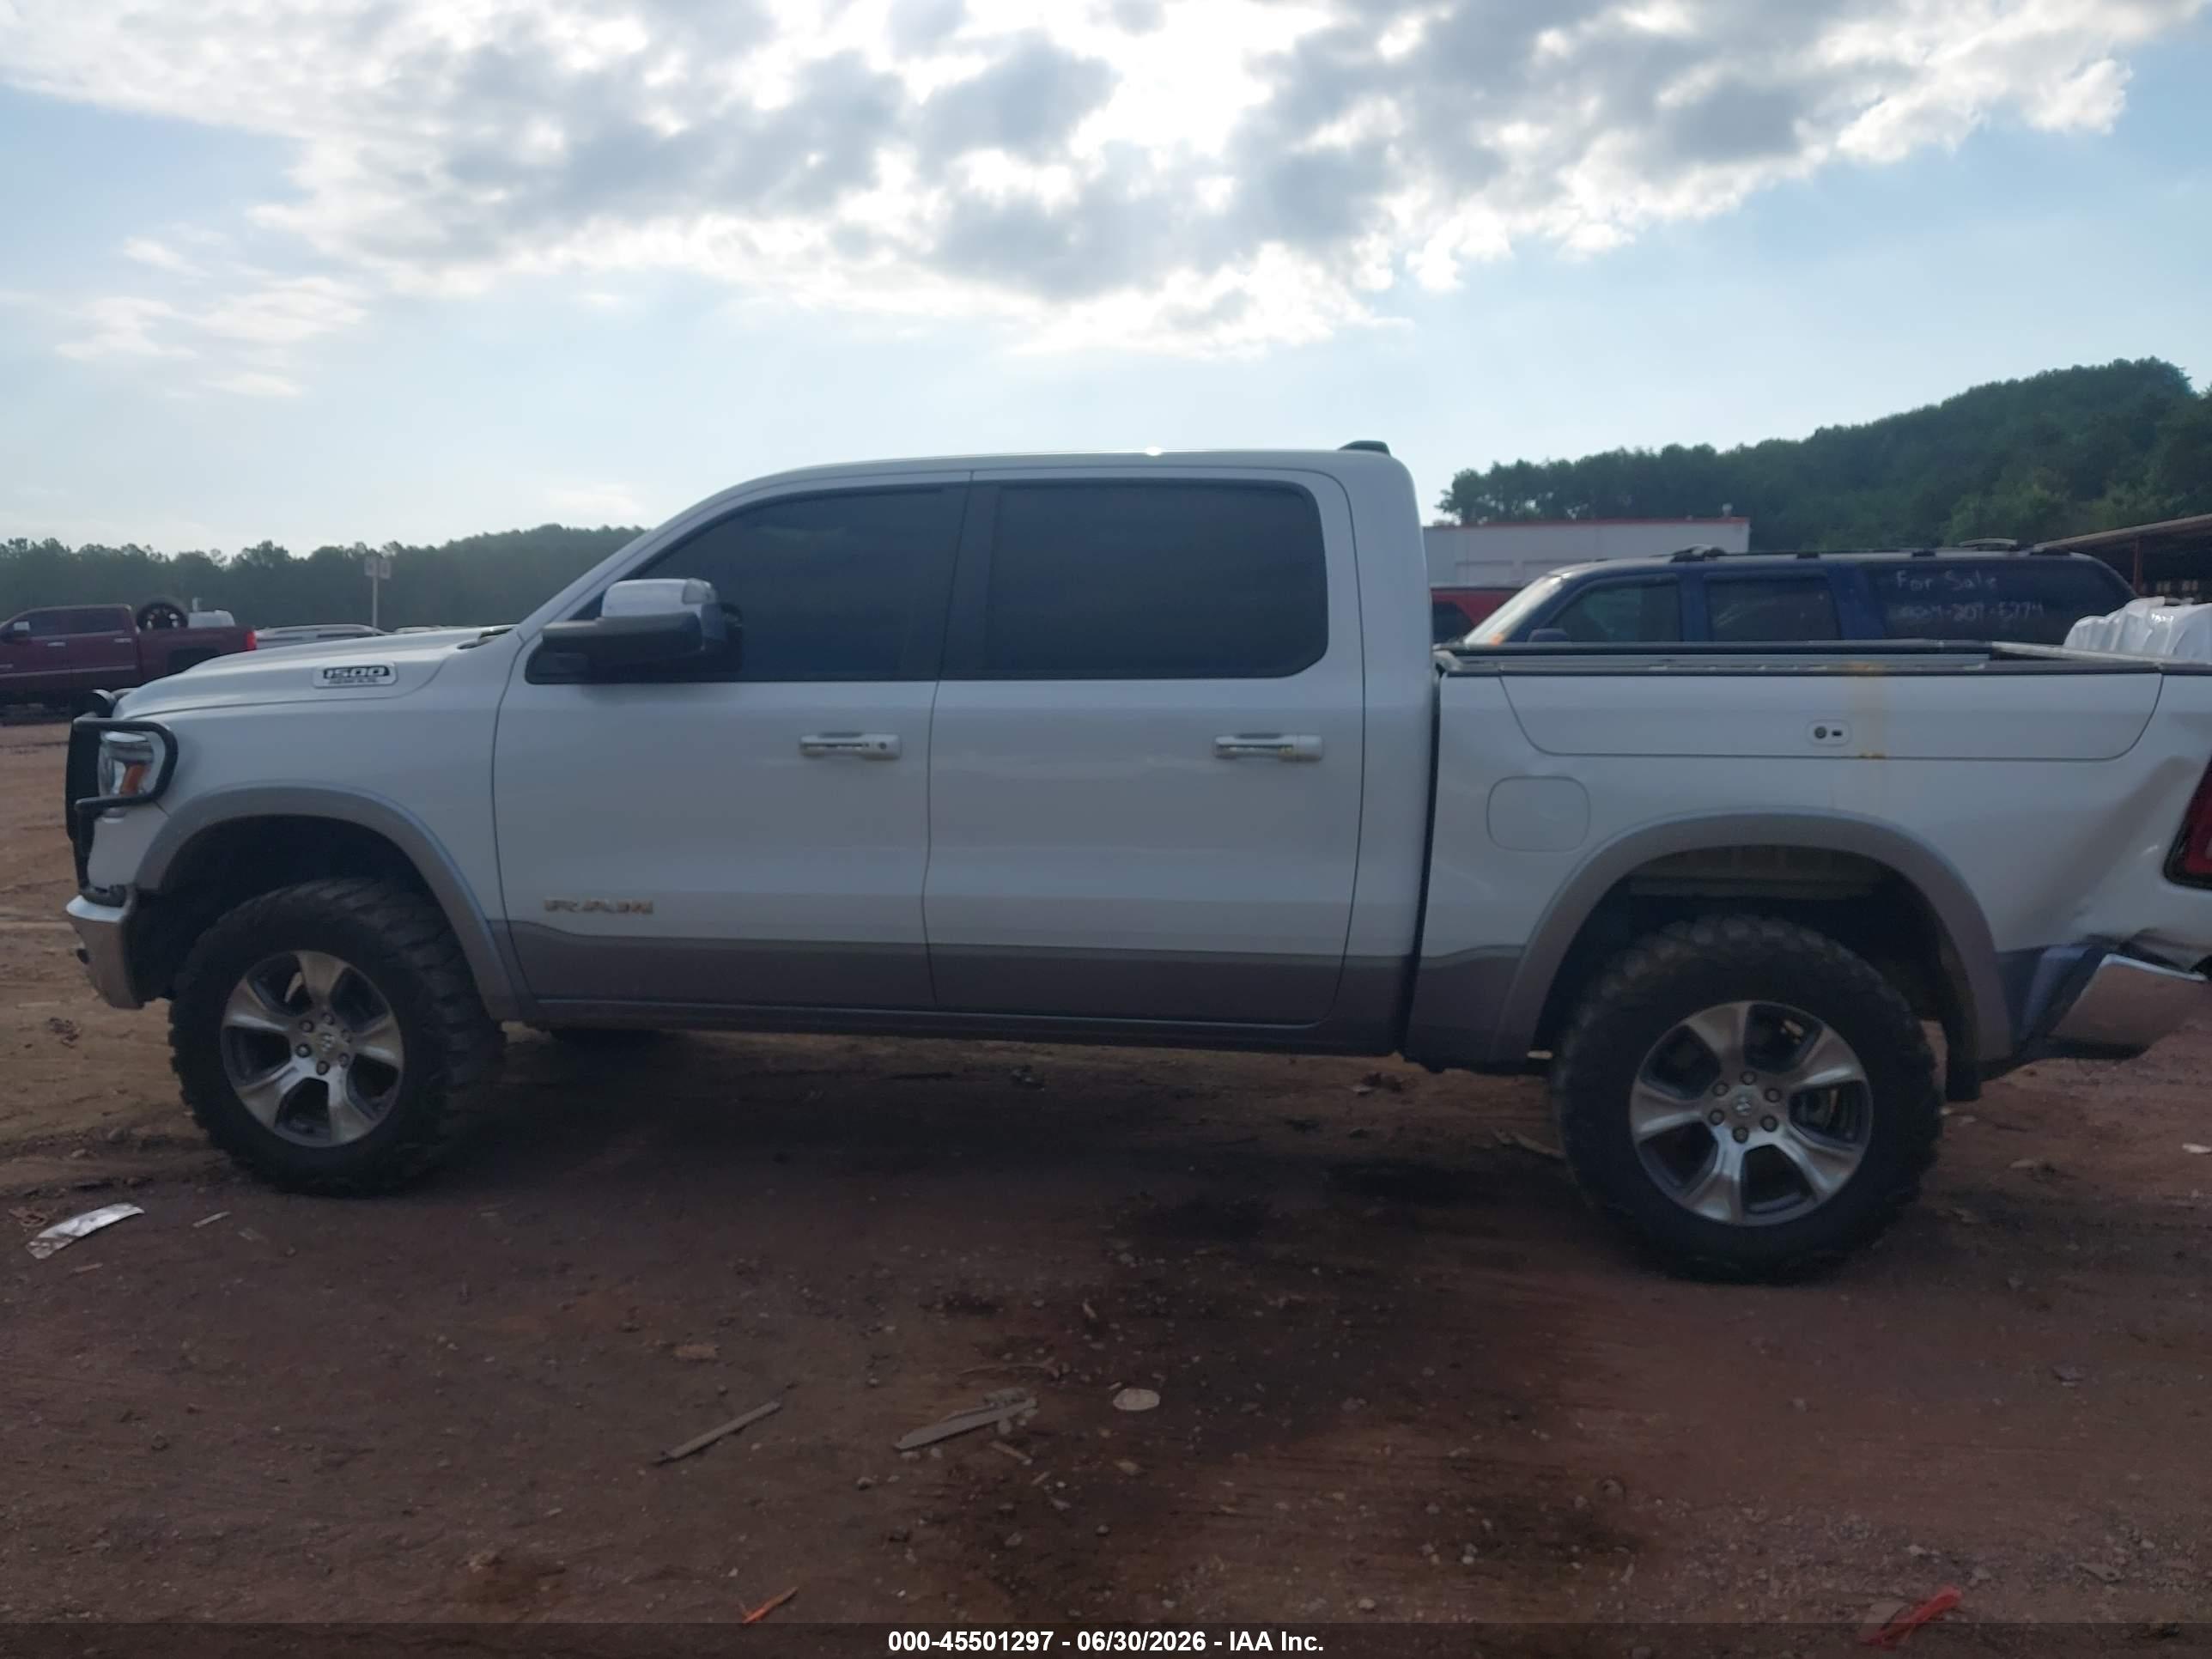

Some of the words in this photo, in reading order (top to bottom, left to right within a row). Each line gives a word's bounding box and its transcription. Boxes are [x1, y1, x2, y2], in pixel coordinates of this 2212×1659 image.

[1895, 569, 1932, 592] For
[1943, 569, 1997, 592] Sale
[325, 666, 387, 678] 1500
[544, 899, 654, 915] RAM
